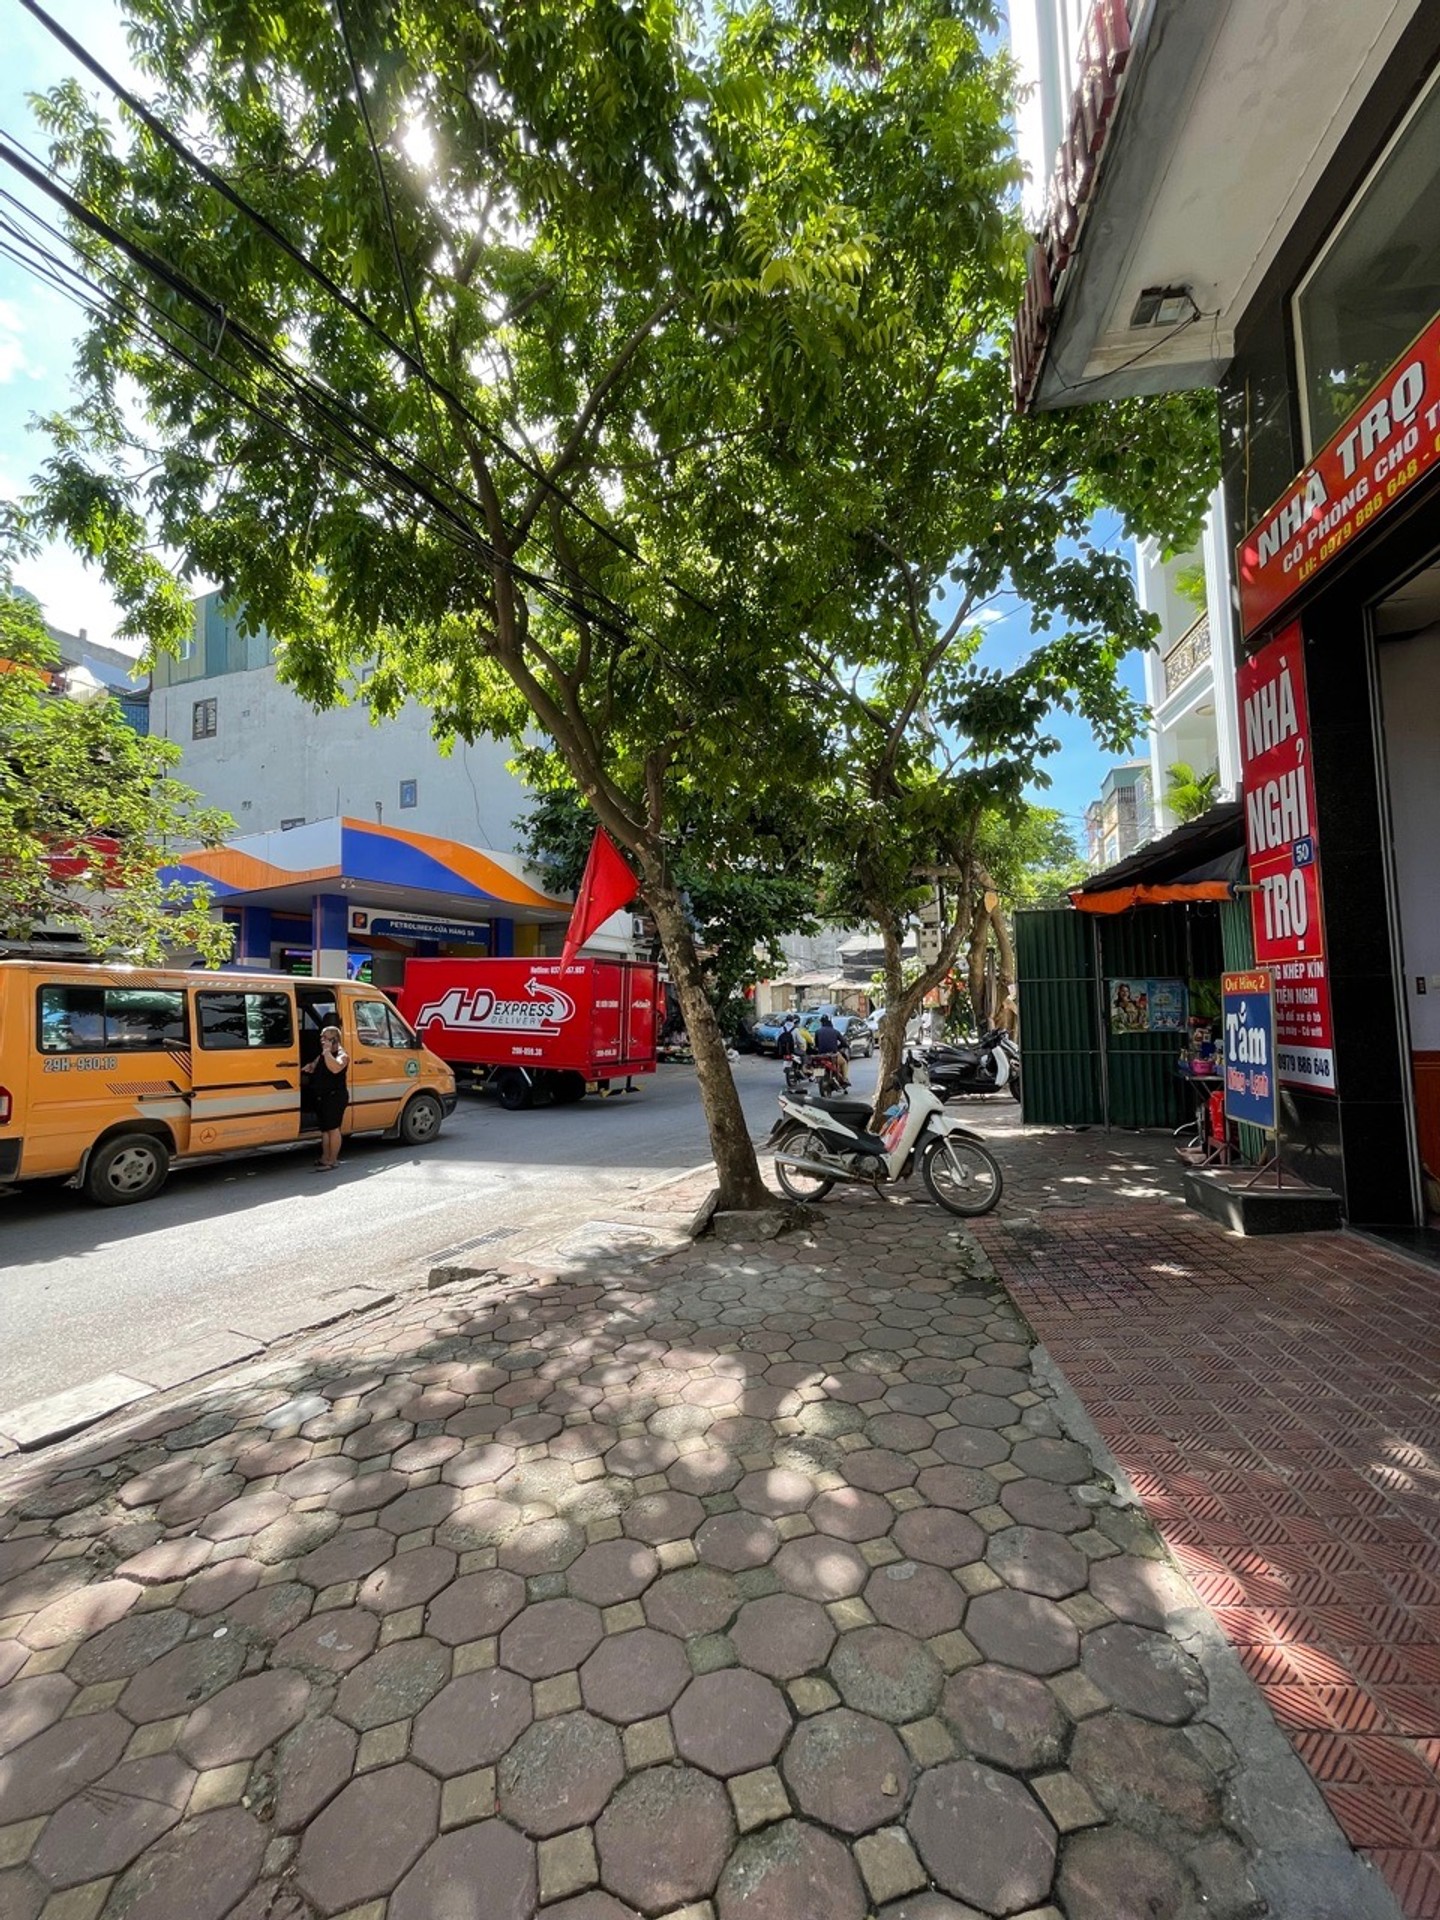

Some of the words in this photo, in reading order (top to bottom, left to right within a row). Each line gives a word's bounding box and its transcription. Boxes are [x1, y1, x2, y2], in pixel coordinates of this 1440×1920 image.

[1257, 468, 1327, 569] NHÀ
[1336, 361, 1424, 480] TRỌ
[1283, 539, 1303, 573] CÓ
[1307, 476, 1369, 551] PHÒNG
[1374, 426, 1419, 483] CHO
[1298, 556, 1317, 581] LH:
[1320, 521, 1351, 561] 0979
[1356, 491, 1382, 528] 886
[1387, 458, 1418, 498] 648
[1243, 655, 1298, 761] NHÀ
[1246, 737, 1310, 855] NGHỈ
[1295, 842, 1310, 863] 50
[1260, 867, 1308, 952] TRỌ
[1259, 974, 1265, 989] 2
[1306, 958, 1325, 978] KÍN
[490, 1015, 543, 1026] DELIVERY
[493, 1002, 555, 1017] EXPRESS
[1313, 1057, 1330, 1077] 648
